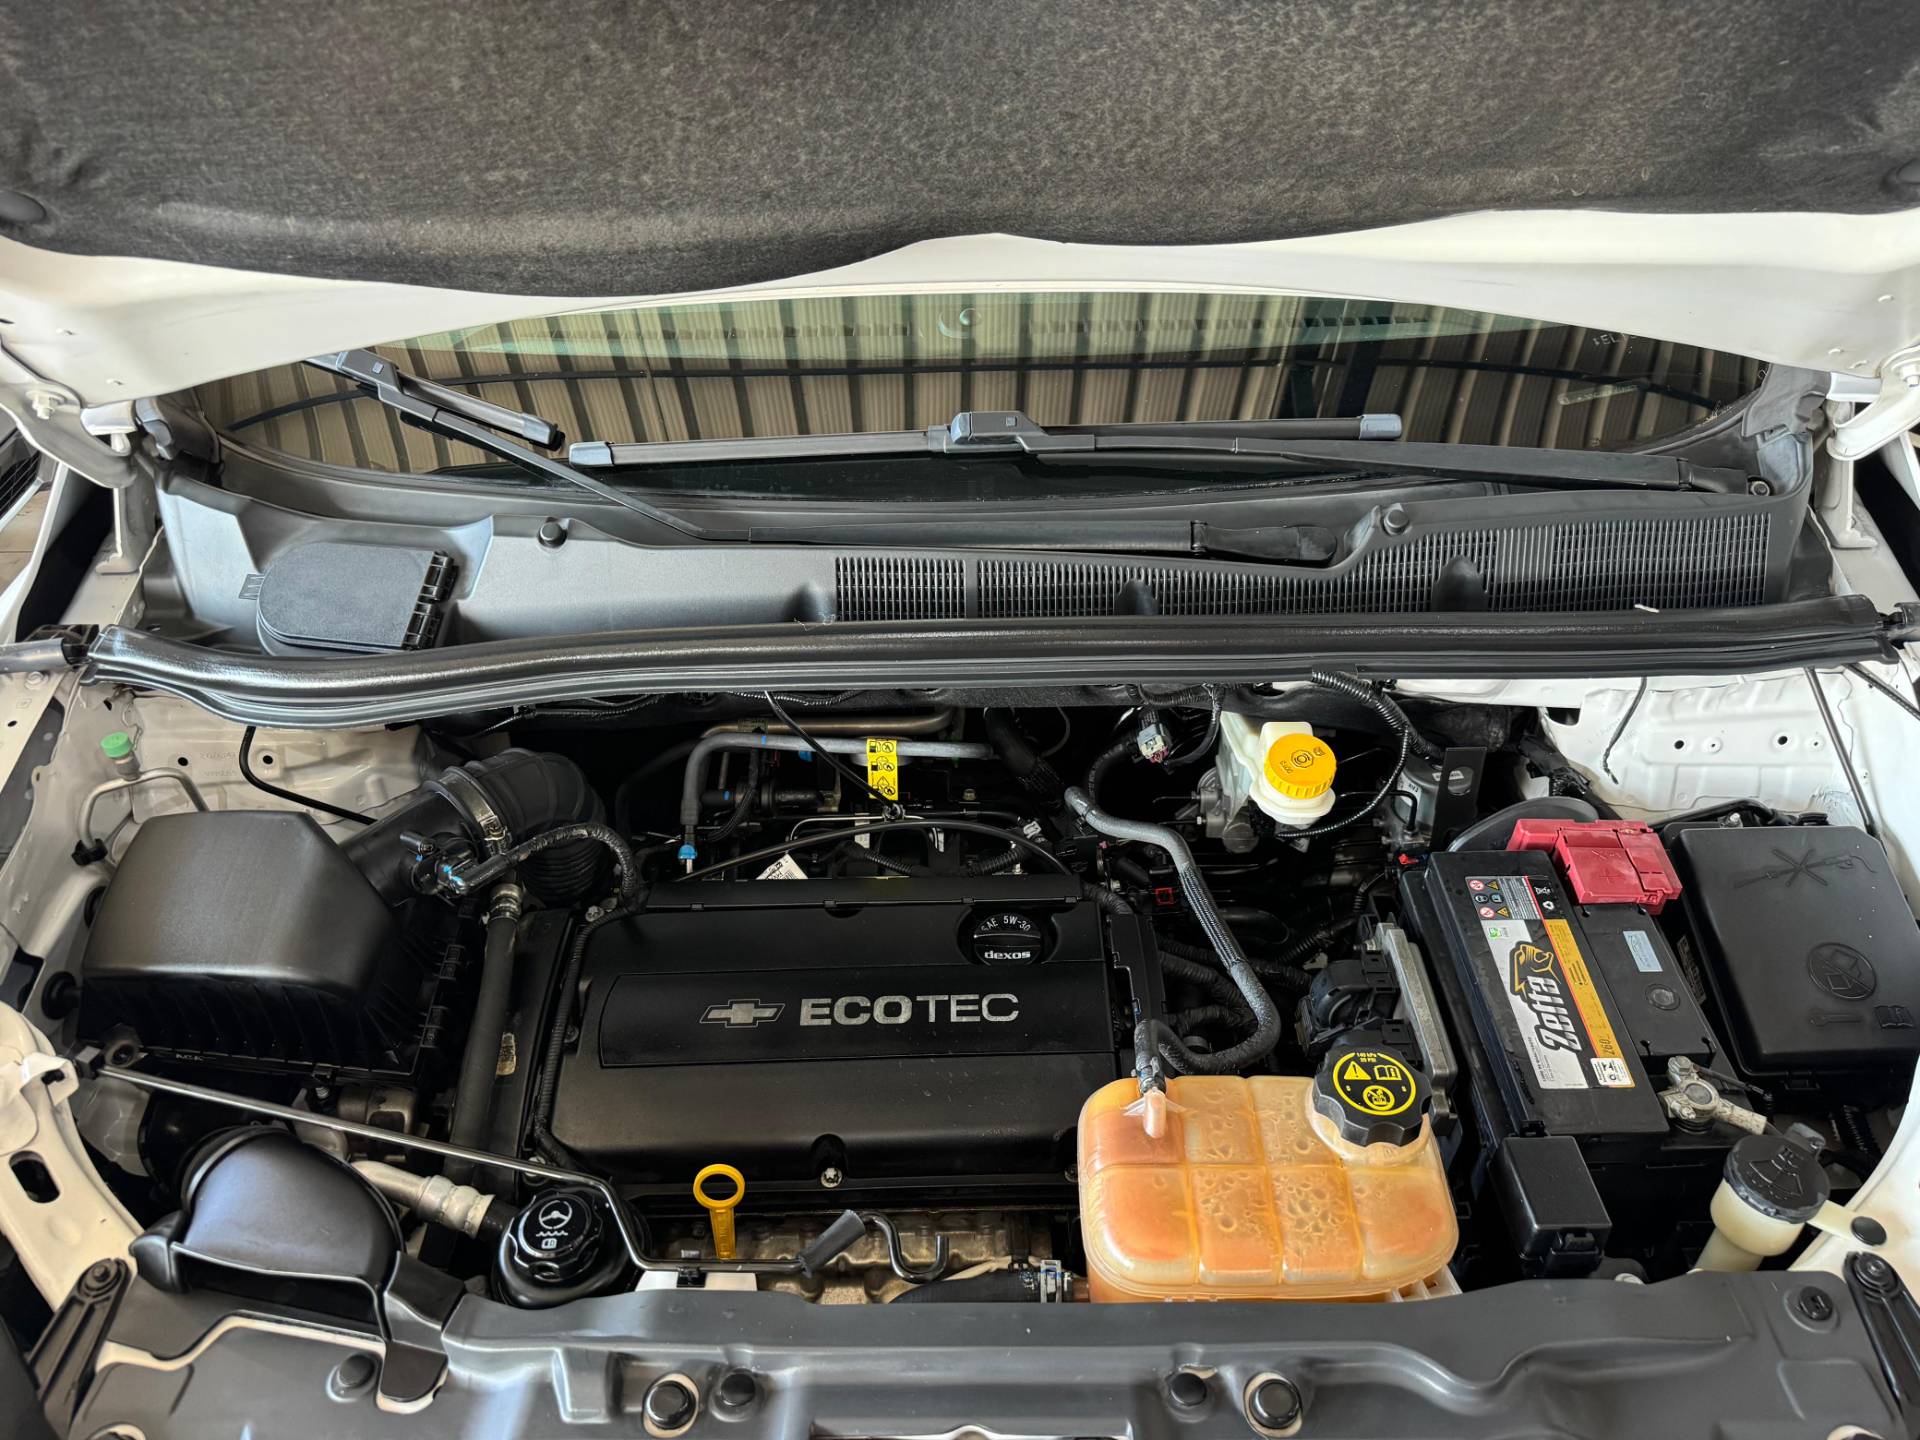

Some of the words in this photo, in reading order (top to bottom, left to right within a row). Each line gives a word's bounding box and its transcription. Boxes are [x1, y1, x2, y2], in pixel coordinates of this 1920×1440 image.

[980, 917, 999, 932] SAE
[1003, 915, 1031, 931] 5W-30
[984, 950, 1031, 960] dexos
[799, 993, 1019, 1026] ECOTEC
[1527, 975, 1583, 1051] Zetta
